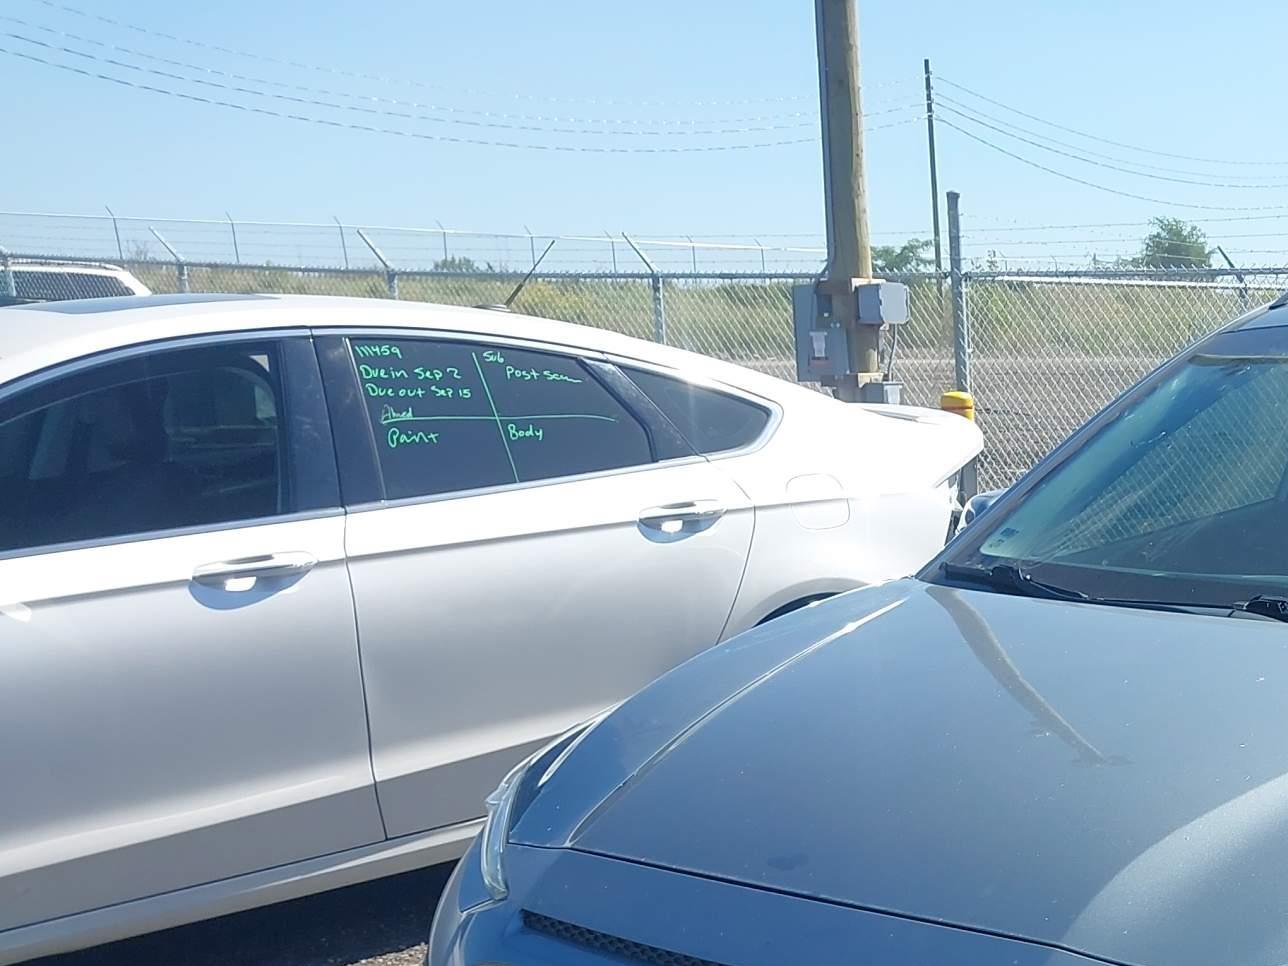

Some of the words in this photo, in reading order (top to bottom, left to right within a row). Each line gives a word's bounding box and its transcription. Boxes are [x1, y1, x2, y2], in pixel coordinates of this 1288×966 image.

[414, 367, 443, 380] Sep
[446, 368, 461, 379] 2
[506, 366, 540, 379] Post
[365, 383, 395, 396] Due
[399, 388, 425, 397] out
[430, 386, 453, 397] Sep
[459, 389, 471, 398] 15
[388, 427, 439, 447] Paint
[508, 424, 543, 440] Body
